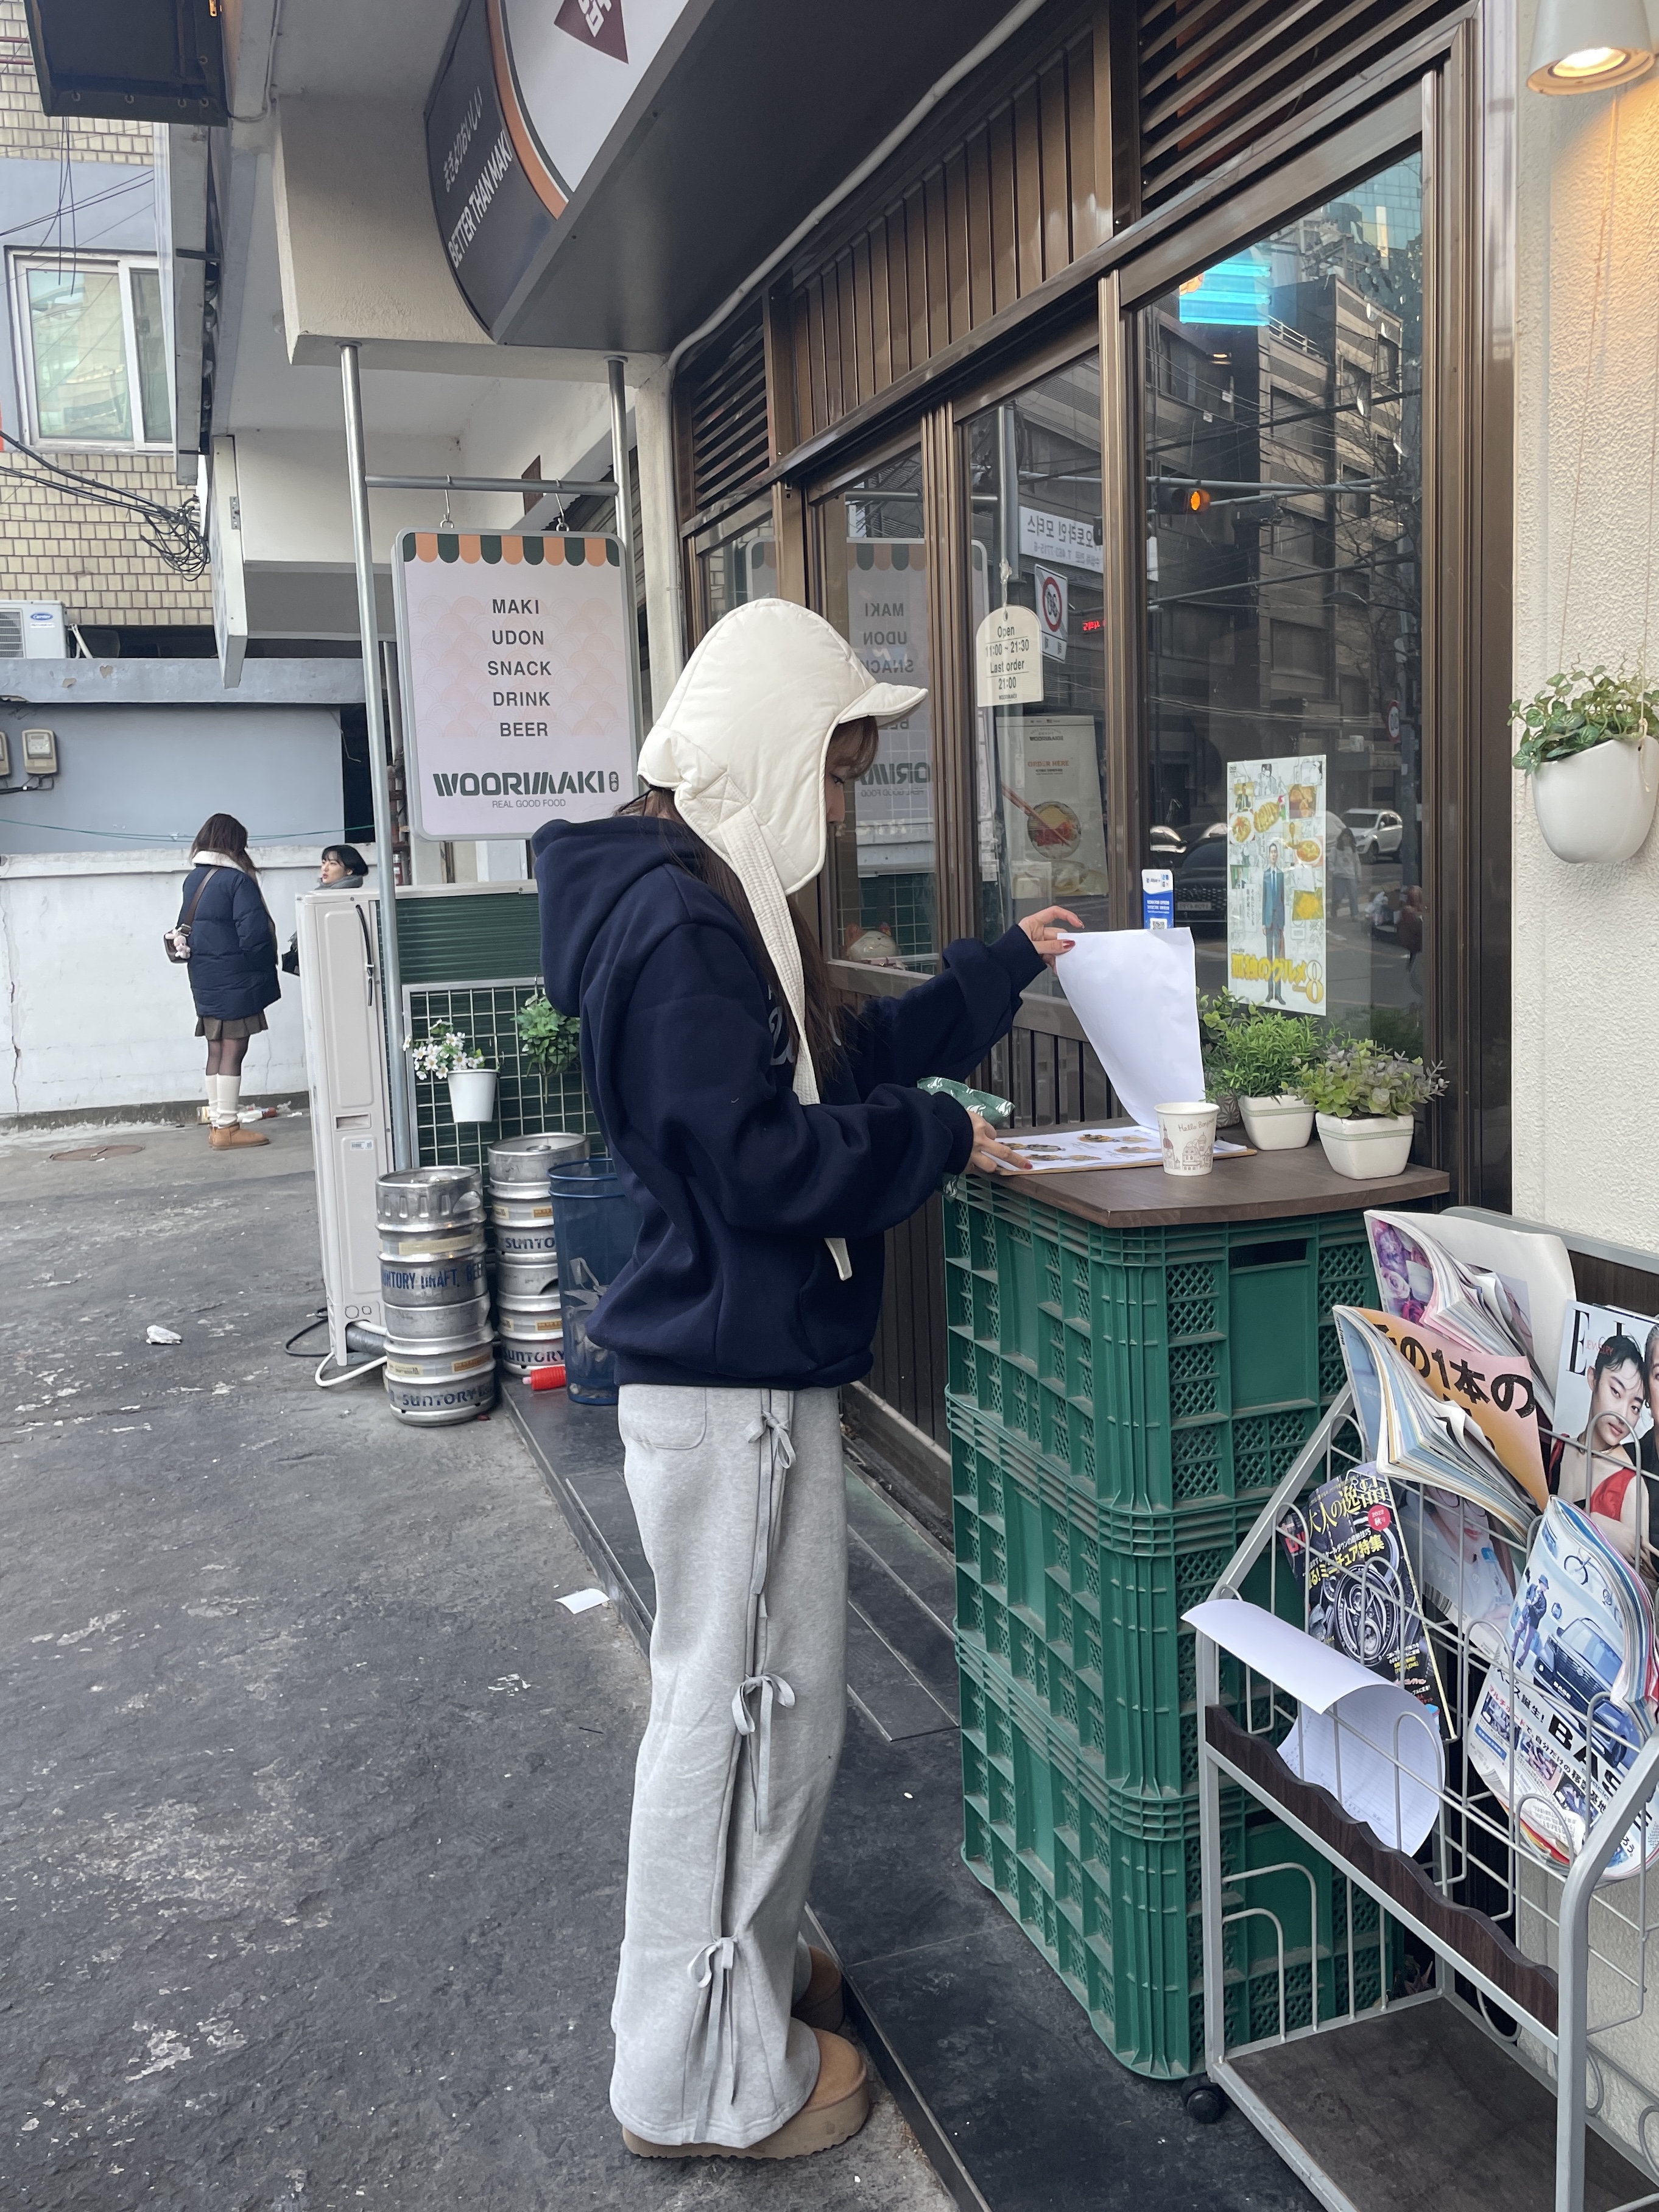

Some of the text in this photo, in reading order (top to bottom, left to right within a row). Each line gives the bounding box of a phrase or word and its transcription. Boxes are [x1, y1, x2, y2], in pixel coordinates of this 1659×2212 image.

[448, 129, 512, 269] BETTER THAN MAKI
[492, 599, 539, 614] MAKI
[491, 630, 544, 645] UDON
[997, 626, 1015, 638] Open
[985, 643, 1002, 657] 11:00
[1010, 639, 1029, 653] 21:30
[488, 660, 552, 676] SNACK
[990, 659, 1025, 674] Last order
[998, 676, 1016, 690] 21:00
[493, 691, 551, 706] DRINK
[500, 722, 548, 737] BEER
[432, 771, 605, 796] WOORIMAKI
[492, 799, 566, 808] REAL GOOD FOOD
[1306, 959, 1324, 1004] 8
[1178, 1123, 1197, 1133] Hello
[504, 1237, 555, 1249] SUNTO
[403, 1389, 477, 1407] SUNTORY
[1372, 1509, 1384, 1518] 2022
[1553, 1680, 1572, 1700] BASE
